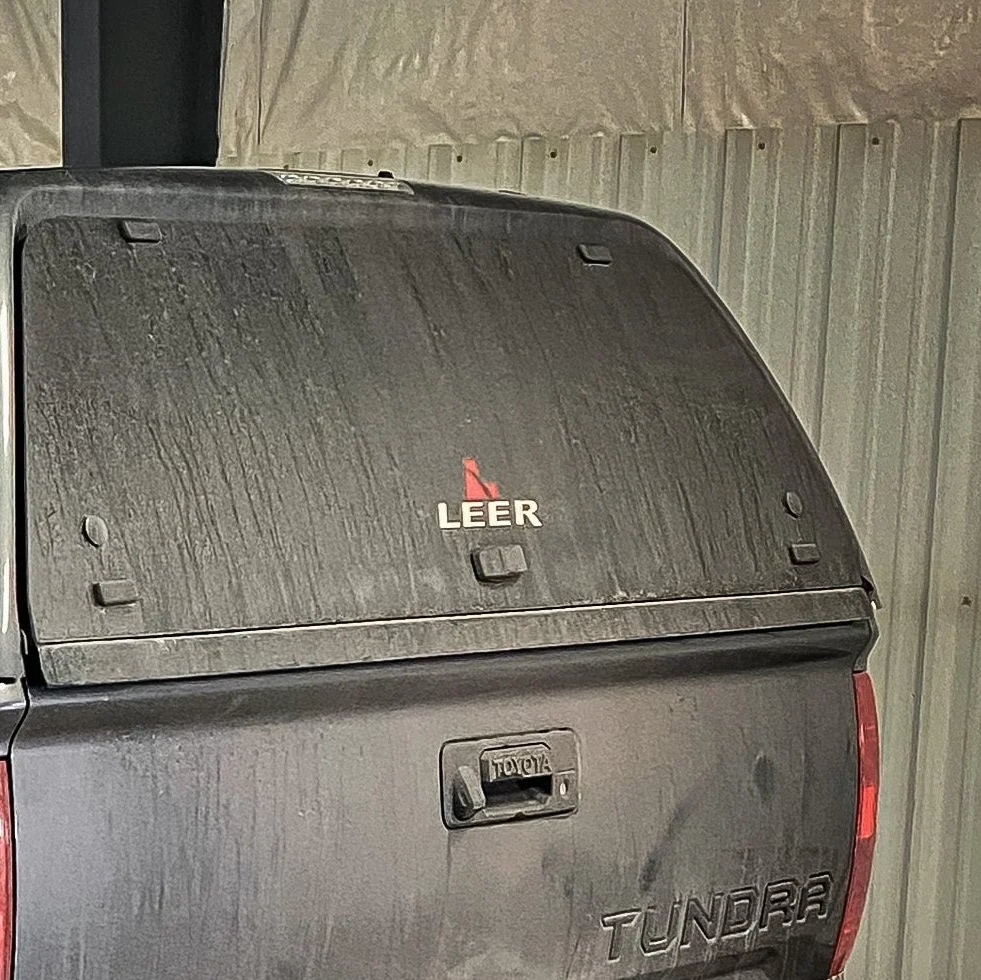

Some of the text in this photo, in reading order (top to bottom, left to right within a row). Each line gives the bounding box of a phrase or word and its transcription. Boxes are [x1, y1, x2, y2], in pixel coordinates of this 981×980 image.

[437, 499, 543, 529] LEER
[491, 753, 553, 778] TOYOTA
[600, 872, 834, 963] TUNDRA
